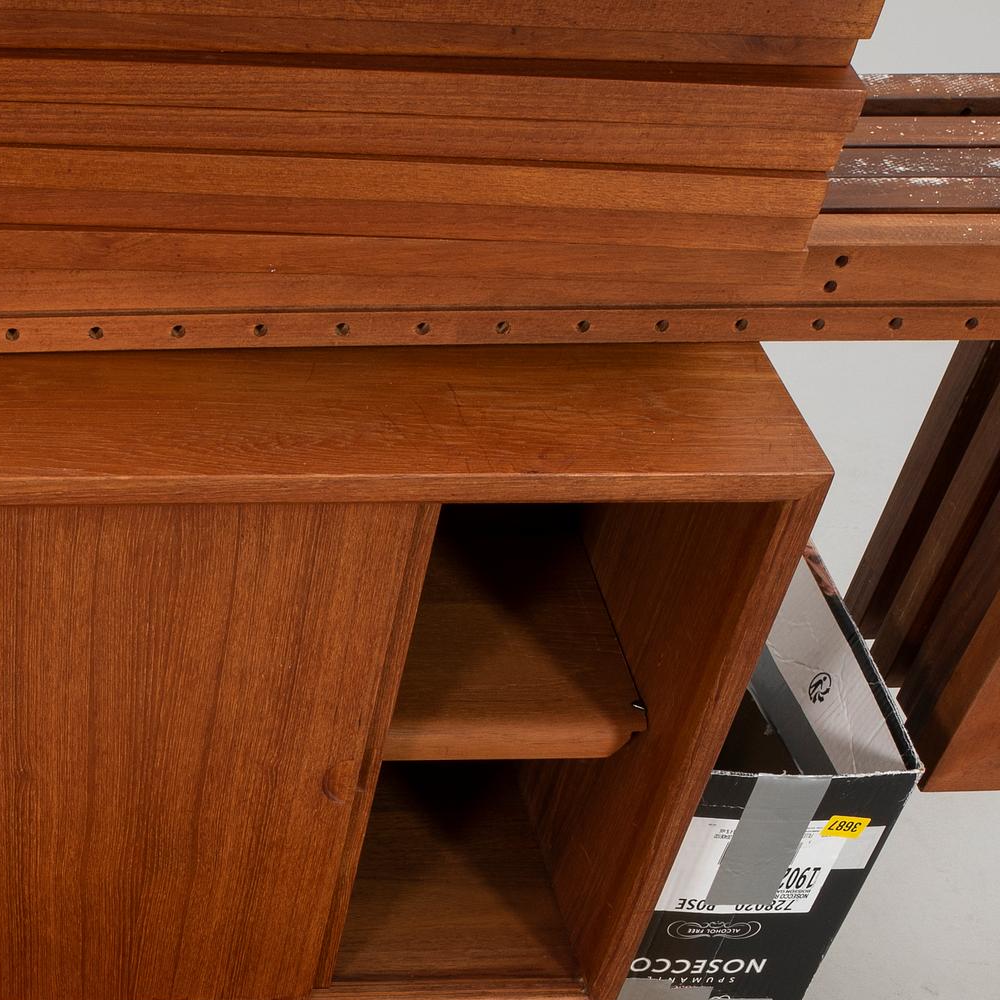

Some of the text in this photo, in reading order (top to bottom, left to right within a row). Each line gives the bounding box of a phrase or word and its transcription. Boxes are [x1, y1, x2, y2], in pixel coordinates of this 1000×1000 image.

[827, 820, 862, 833] 3687
[630, 957, 768, 974] NOSECCO
[647, 975, 736, 984] SPUMAN
